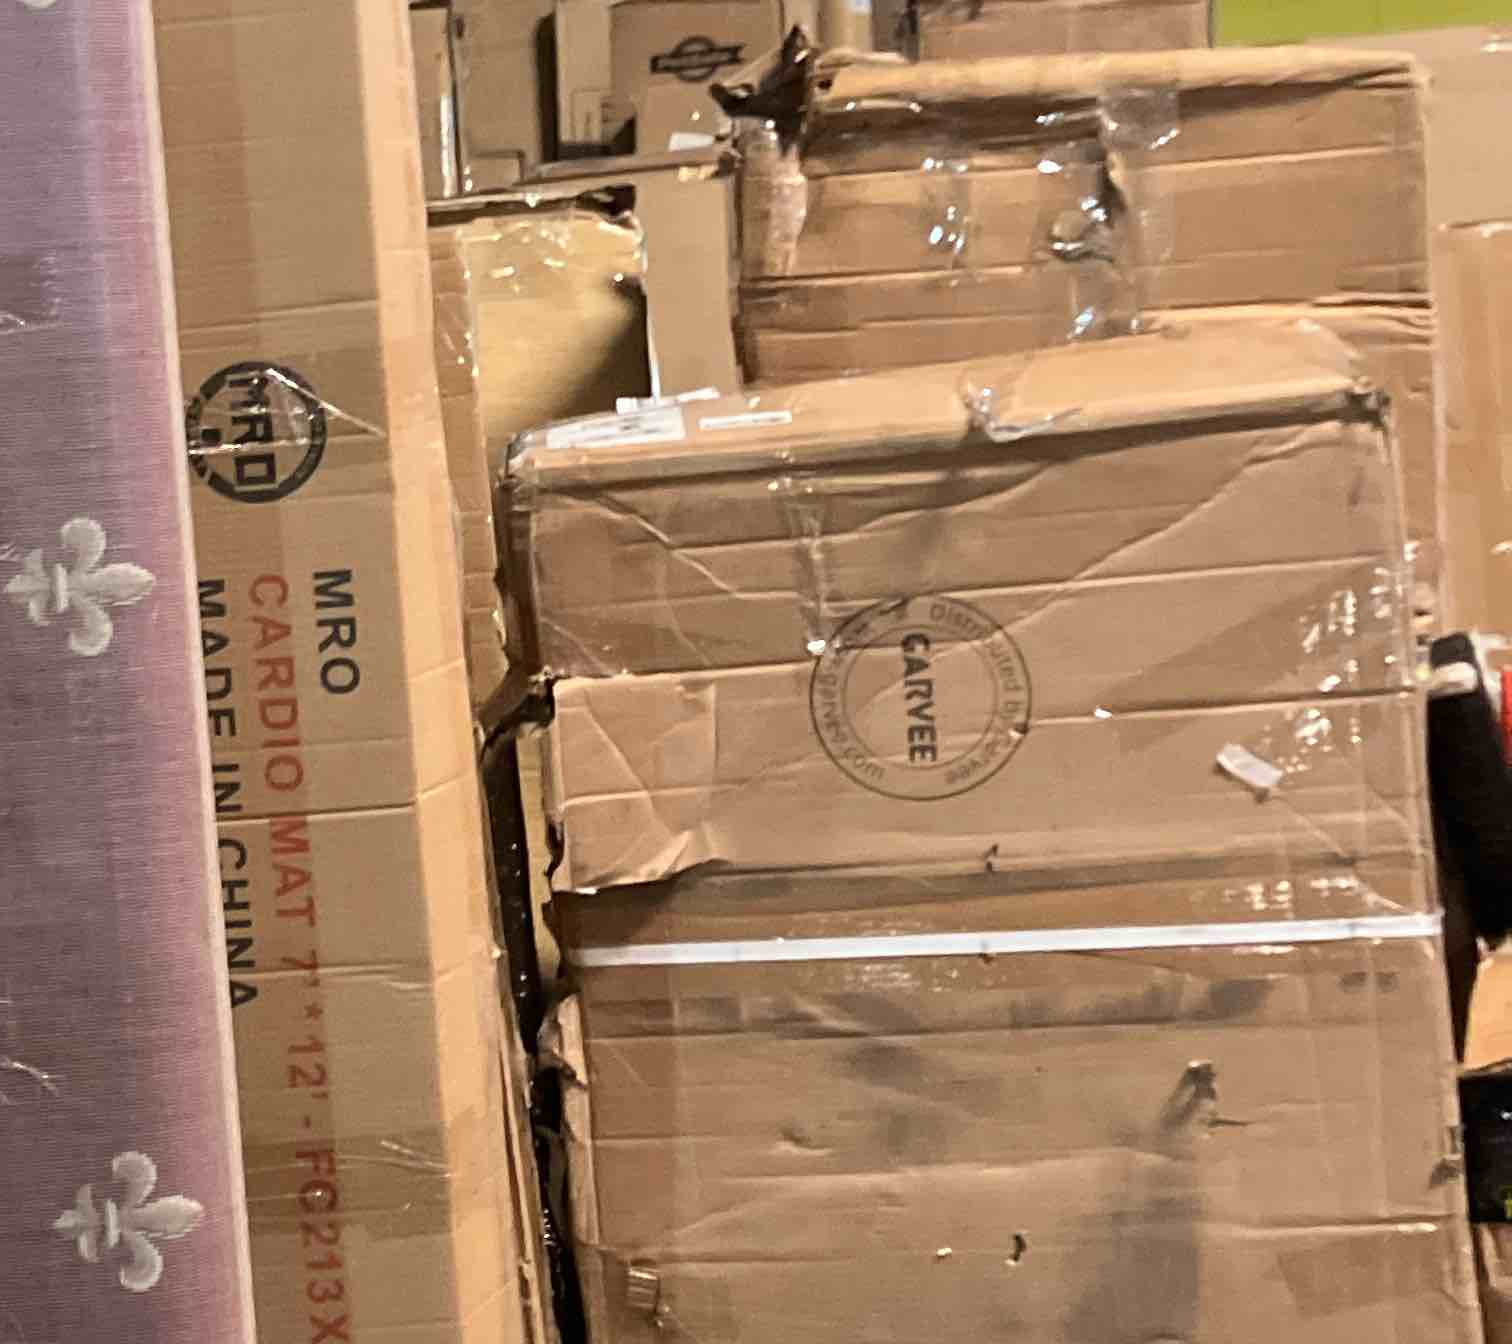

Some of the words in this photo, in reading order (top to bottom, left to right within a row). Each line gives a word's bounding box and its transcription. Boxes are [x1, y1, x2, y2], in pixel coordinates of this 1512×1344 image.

[228, 377, 277, 484] MRO
[198, 578, 237, 737] MADE
[249, 573, 304, 791] CARDIO
[313, 569, 361, 695] MRO
[211, 763, 244, 813] IN
[217, 837, 259, 1009] CHINA
[269, 815, 318, 928] MAT
